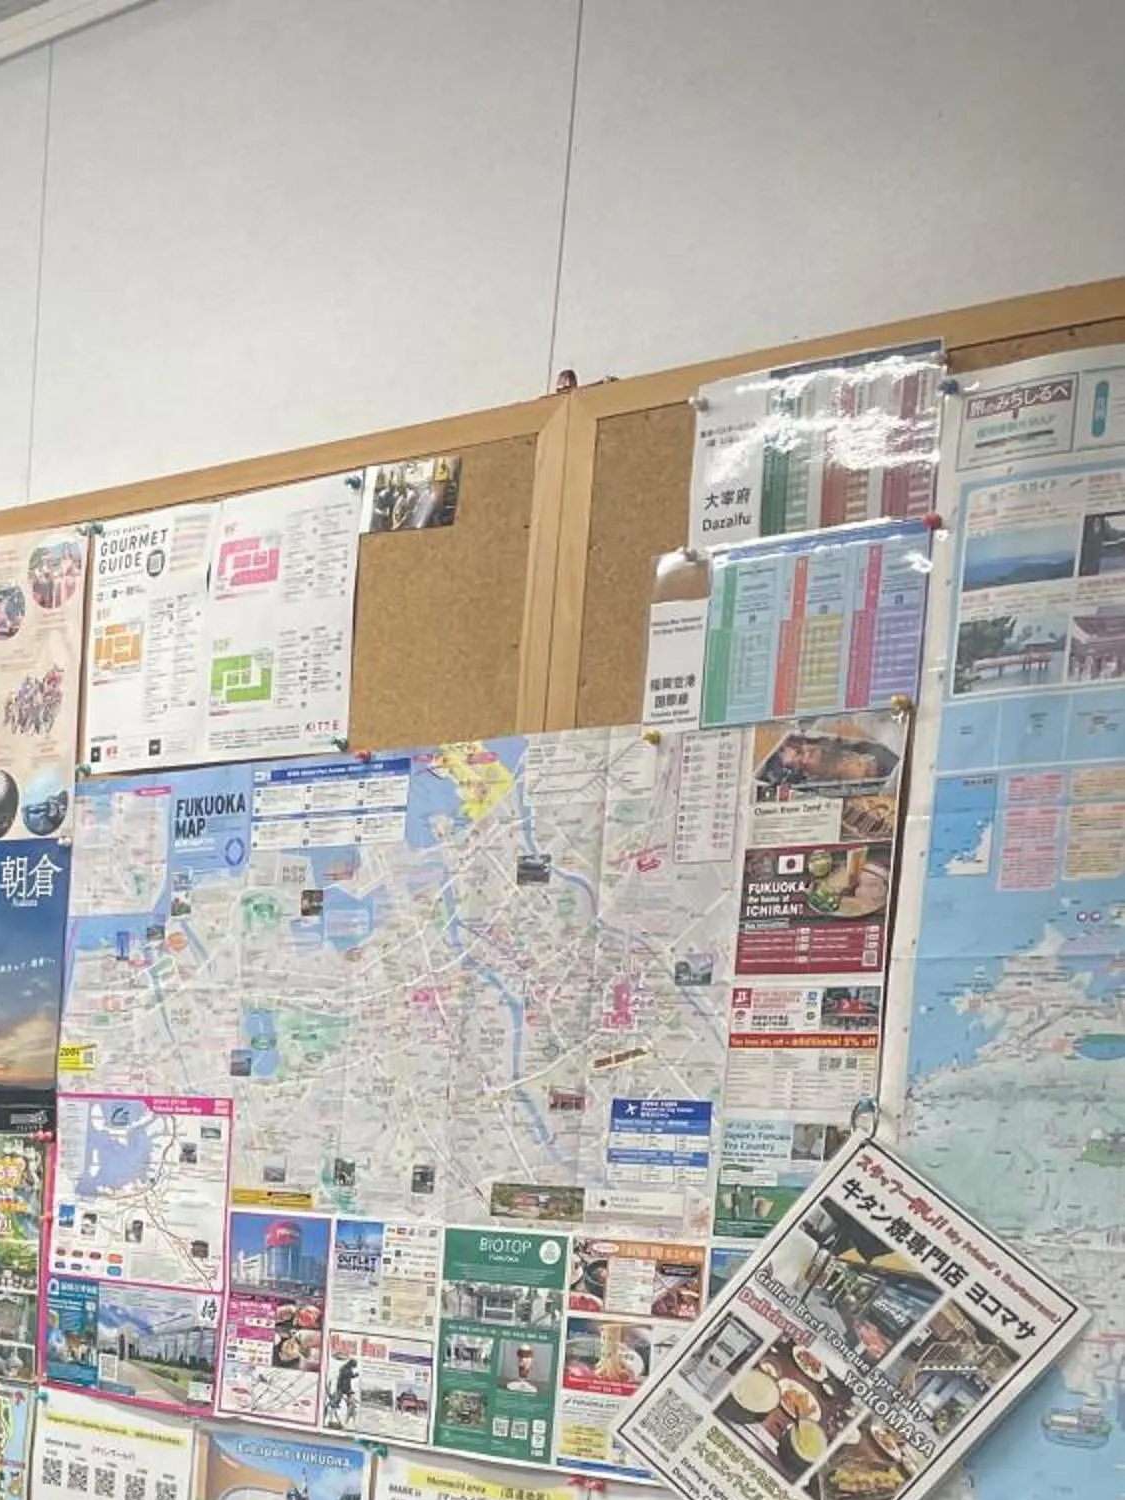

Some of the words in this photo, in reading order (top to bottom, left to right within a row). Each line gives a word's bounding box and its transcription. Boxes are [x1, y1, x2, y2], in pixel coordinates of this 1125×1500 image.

[703, 512, 751, 533] Dazaifu
[100, 528, 169, 558] GOURMET
[98, 551, 143, 575] GUIDE
[305, 721, 339, 733] KITTE
[175, 792, 246, 819] FUKUOKA
[174, 818, 206, 839] MAP
[479, 1237, 532, 1254] BIOTOP
[337, 1253, 378, 1266] OUTLET
[840, 1177, 970, 1290] 牛タン焼専門店
[963, 1281, 1038, 1344] ヨコマサ
[793, 1301, 827, 1334] Beef
[822, 1327, 874, 1377] Tongue
[842, 1370, 938, 1459] YOKOMASA
